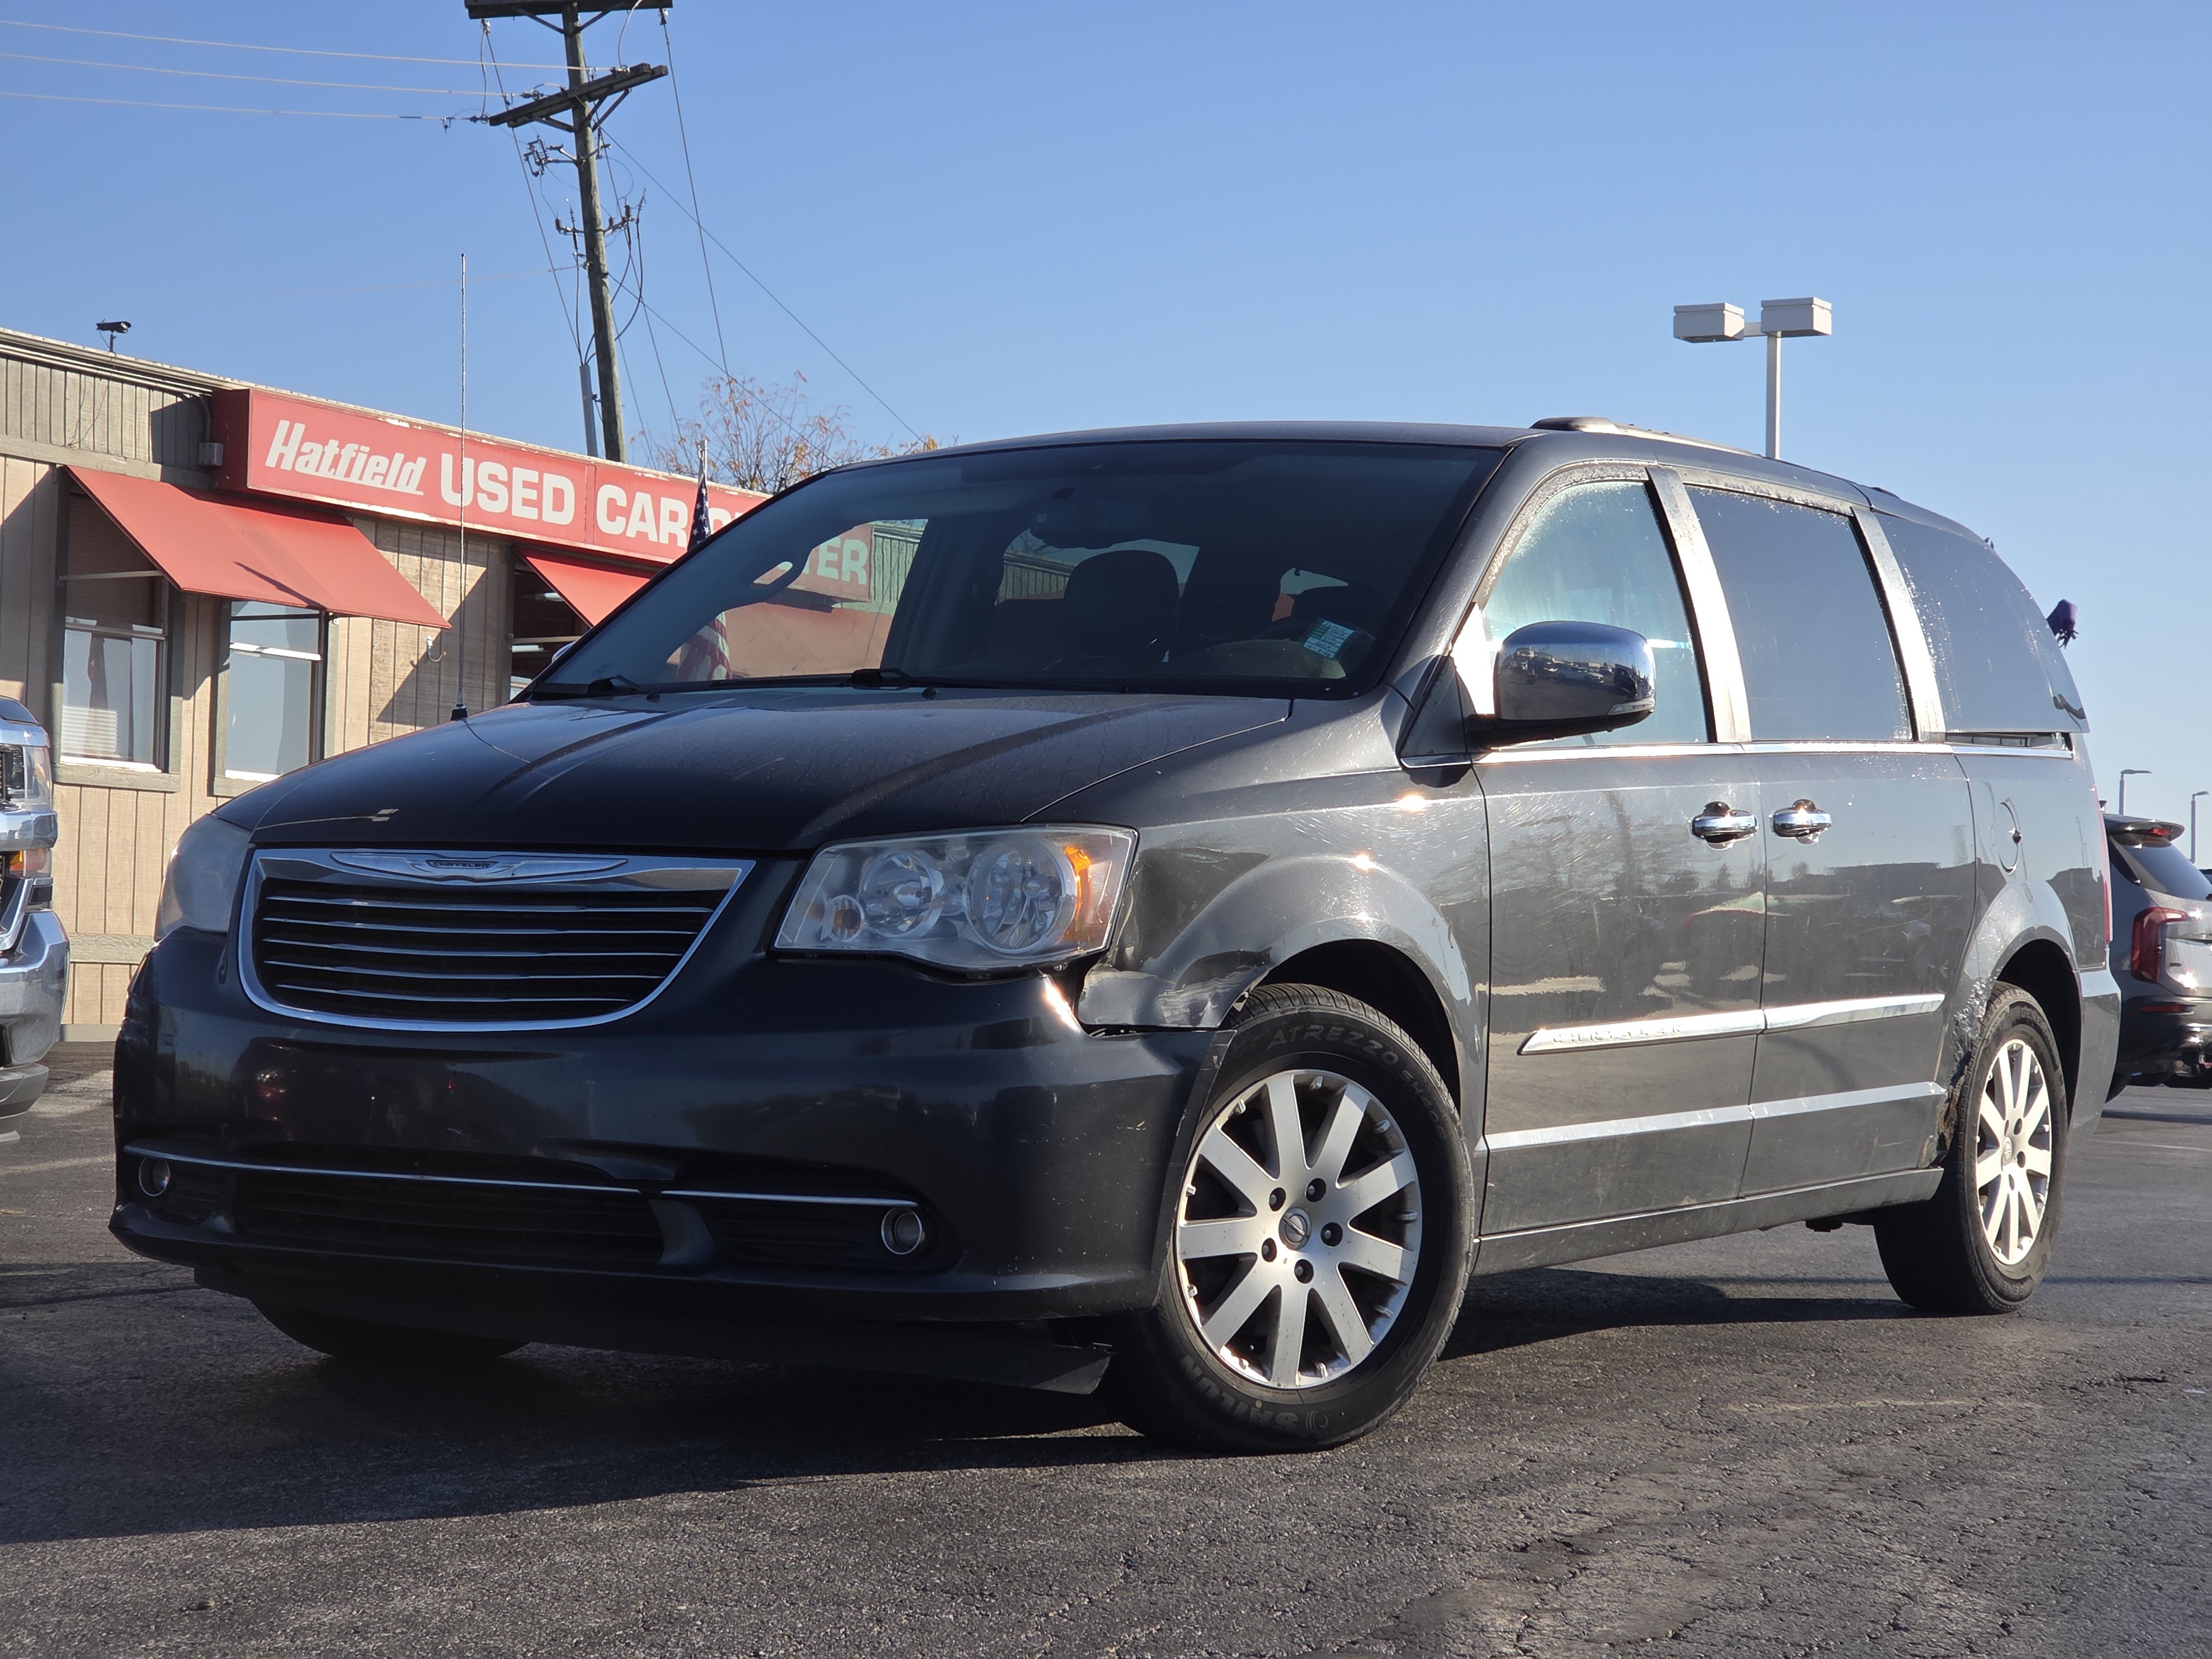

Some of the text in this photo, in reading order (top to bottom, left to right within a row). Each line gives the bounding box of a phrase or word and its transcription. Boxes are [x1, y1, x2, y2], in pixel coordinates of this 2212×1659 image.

[265, 419, 427, 496] Hatfield
[441, 452, 575, 525] USED
[597, 484, 688, 548] CAR
[1266, 1024, 1399, 1065] ATREZZO
[1552, 1024, 1681, 1045] CHRYSLER
[1178, 1355, 1298, 1431] SAILUN
